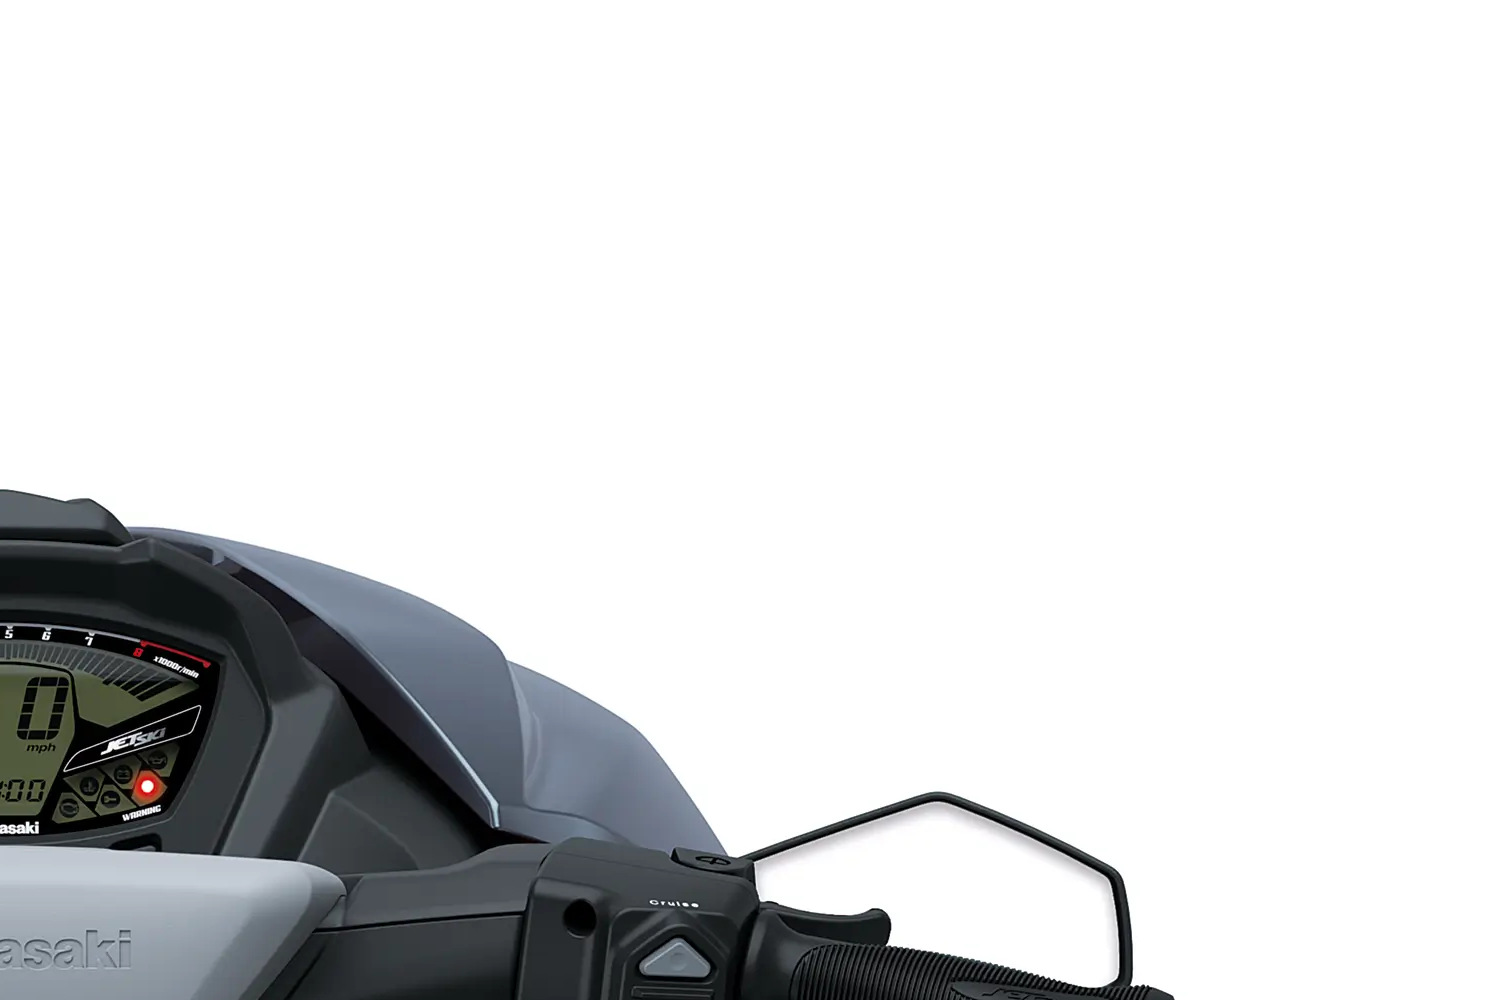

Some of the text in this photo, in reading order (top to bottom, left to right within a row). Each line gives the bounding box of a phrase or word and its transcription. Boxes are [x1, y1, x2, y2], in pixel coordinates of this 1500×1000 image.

[5, 630, 14, 639] 5
[42, 632, 51, 640] 6
[85, 636, 93, 646] 7
[16, 677, 69, 740] 0
[26, 744, 56, 753] mph
[122, 805, 161, 821] WARNING
